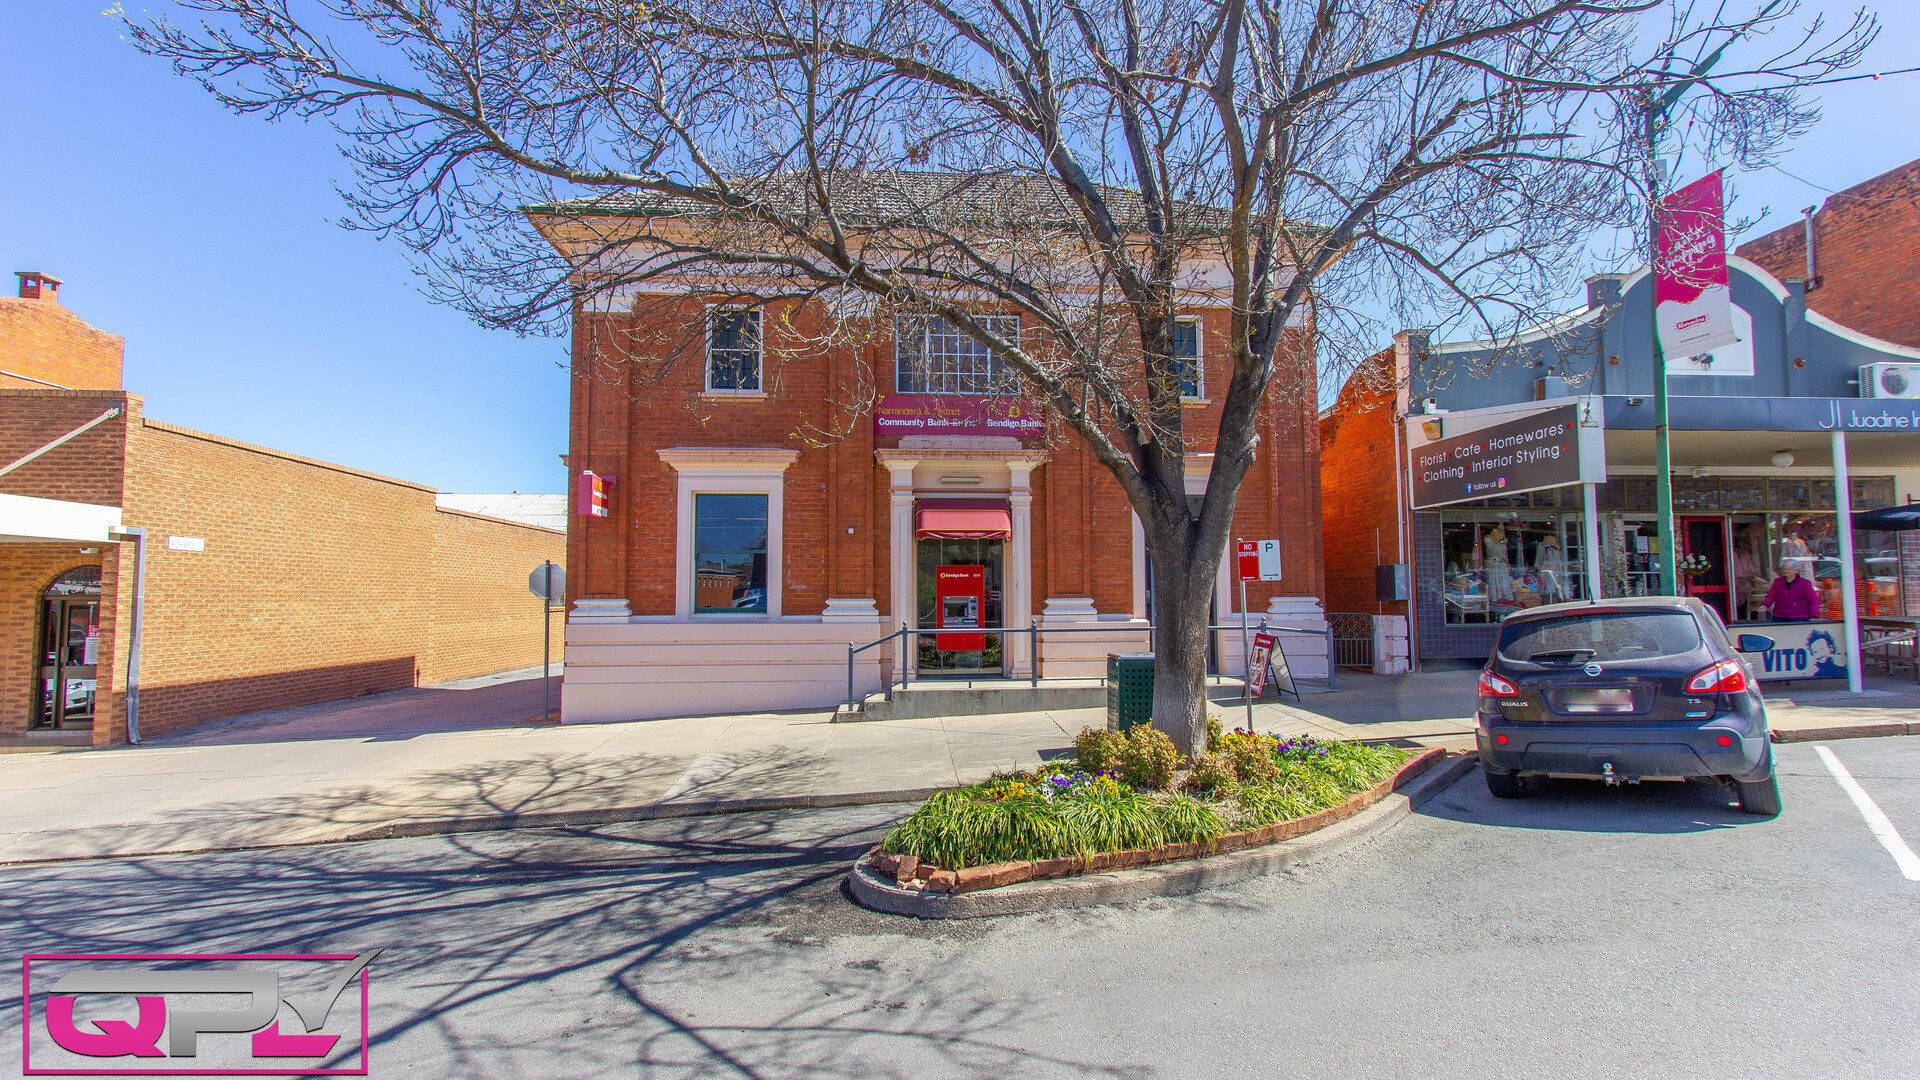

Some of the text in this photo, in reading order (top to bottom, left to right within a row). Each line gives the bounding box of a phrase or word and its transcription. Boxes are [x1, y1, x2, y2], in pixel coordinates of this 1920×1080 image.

[878, 407, 960, 416] Narrandera & District
[878, 418, 925, 428] Community
[927, 418, 950, 427] Bank
[987, 418, 1043, 429] Bendigo Bank
[1847, 410, 1909, 428] Juadine
[1419, 423, 1564, 467] Florist Cafe Homewares
[1423, 443, 1560, 483] Clothing Interior Styling
[1243, 543, 1252, 551] NO
[1265, 542, 1274, 552] P
[1762, 648, 1808, 672] VITO
